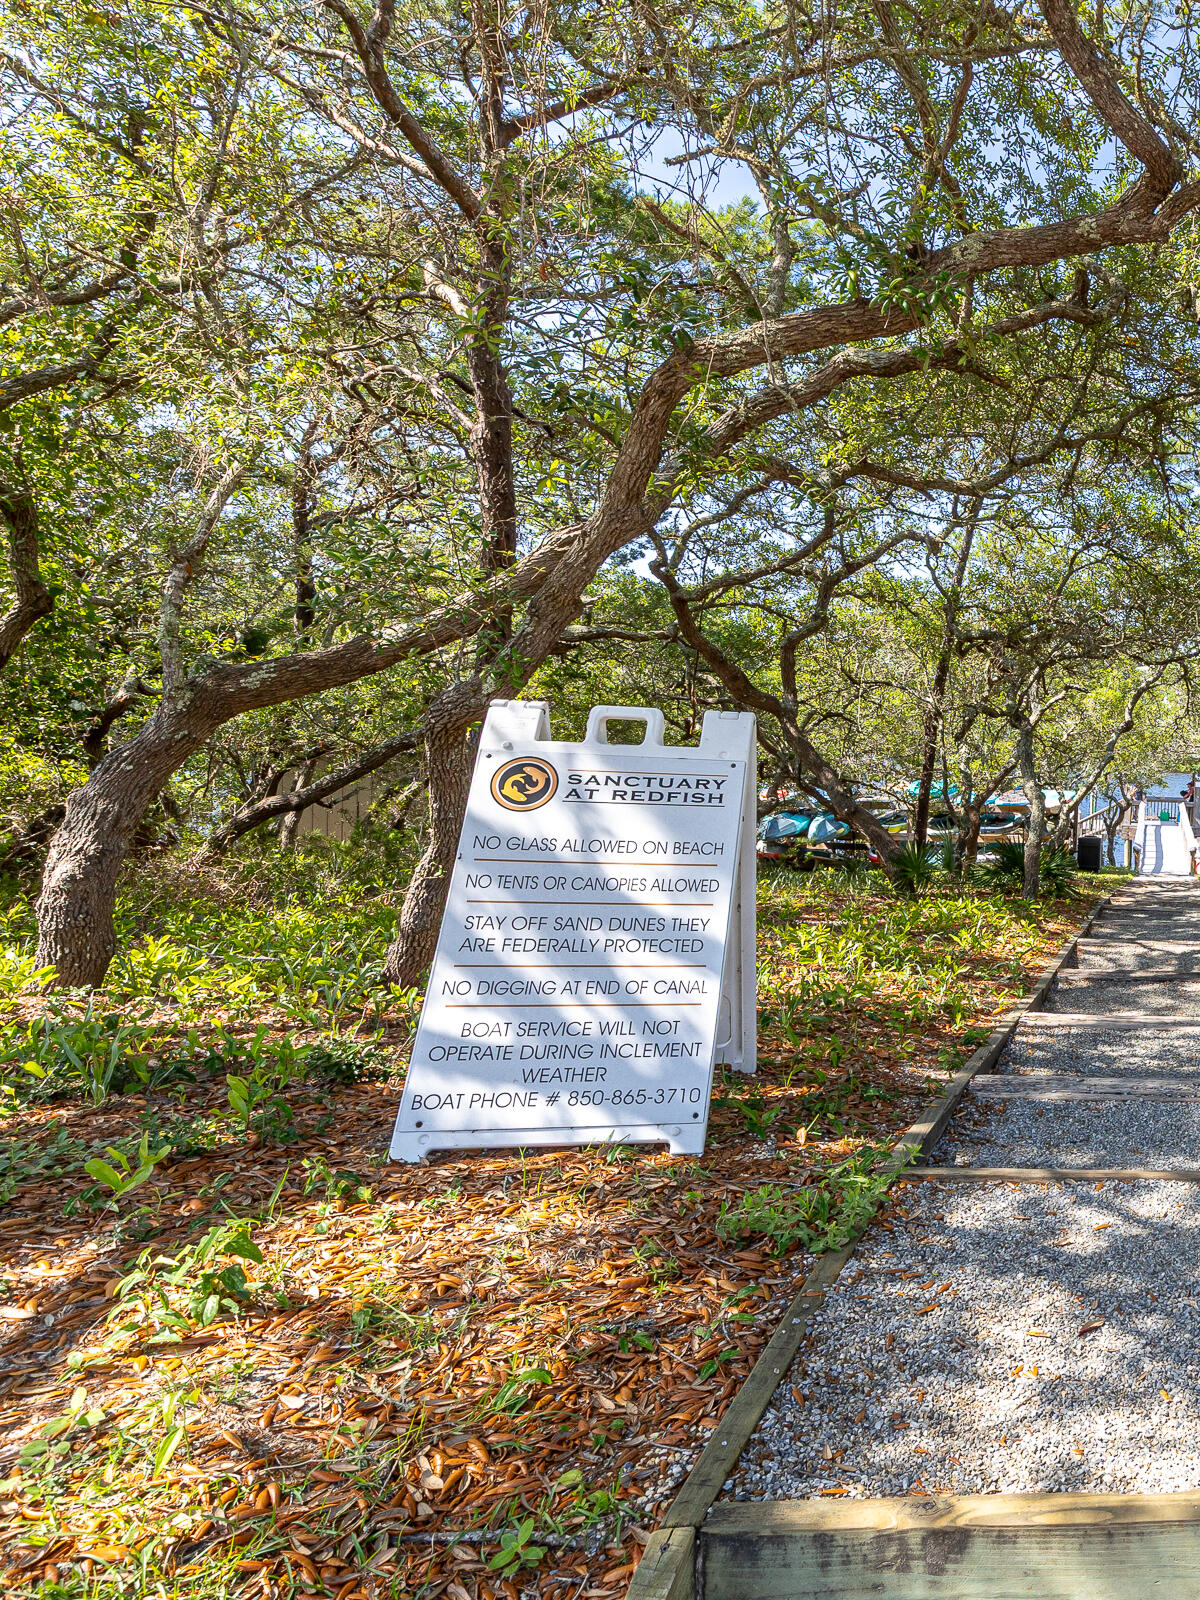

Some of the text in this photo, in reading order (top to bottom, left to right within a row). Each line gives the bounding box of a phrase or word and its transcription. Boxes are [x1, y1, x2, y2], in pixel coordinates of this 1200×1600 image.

[568, 774, 728, 790] SANCTUARY
[564, 788, 724, 804] AT REDFISH
[473, 836, 724, 856] NO GLASS ALLOWED ON BEACH
[466, 874, 720, 893] NO TENTS OR CANOPIES ALLOWED
[464, 916, 710, 932] STAY OFF SAND DUNES THEY
[459, 938, 704, 953] ARE FEDERALLY PROTECTED
[442, 980, 708, 996] NO DIGGING AT END OF CANAL
[461, 1020, 681, 1037] BOAT SERVICE WILL NOT
[428, 1042, 702, 1062] OPERATE DURING INCLEMENT
[522, 1067, 607, 1084] WEATHER
[411, 1088, 701, 1110] BOAT PHONE # 850-865-3710
